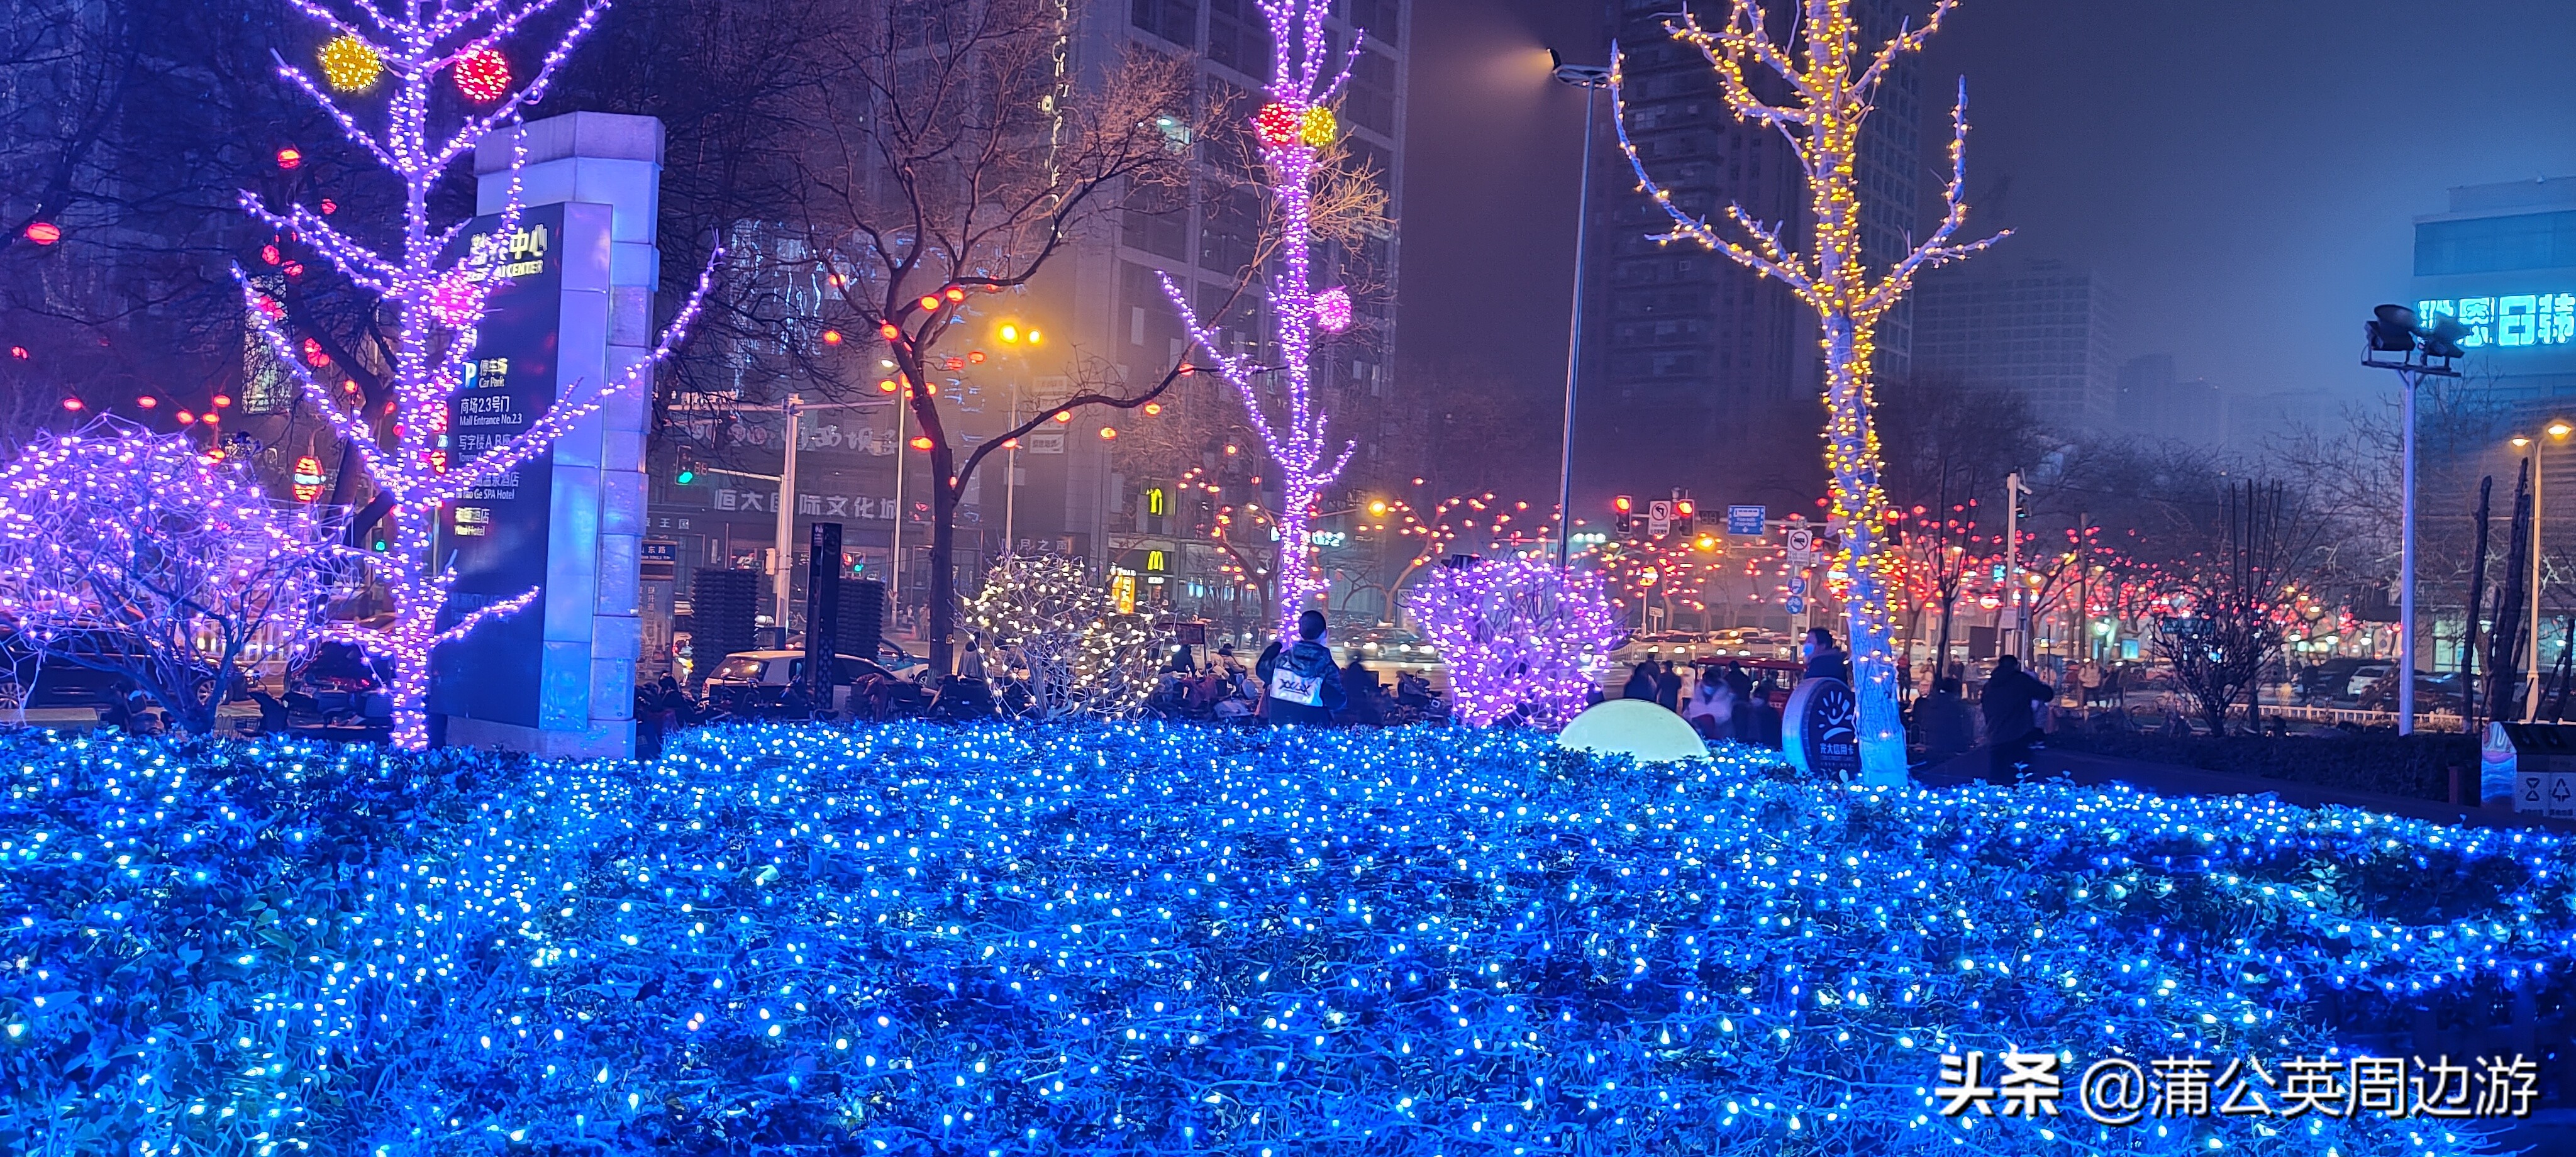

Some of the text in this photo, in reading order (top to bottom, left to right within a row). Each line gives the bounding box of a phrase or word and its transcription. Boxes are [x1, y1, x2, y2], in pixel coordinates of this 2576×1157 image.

[462, 362, 477, 387] P
[479, 376, 504, 388] Car Park
[460, 396, 509, 414] 商场2.3号门
[460, 416, 473, 426] Mall
[474, 416, 500, 425] Entrance
[484, 489, 496, 499] SPA
[497, 489, 514, 499] Hotel
